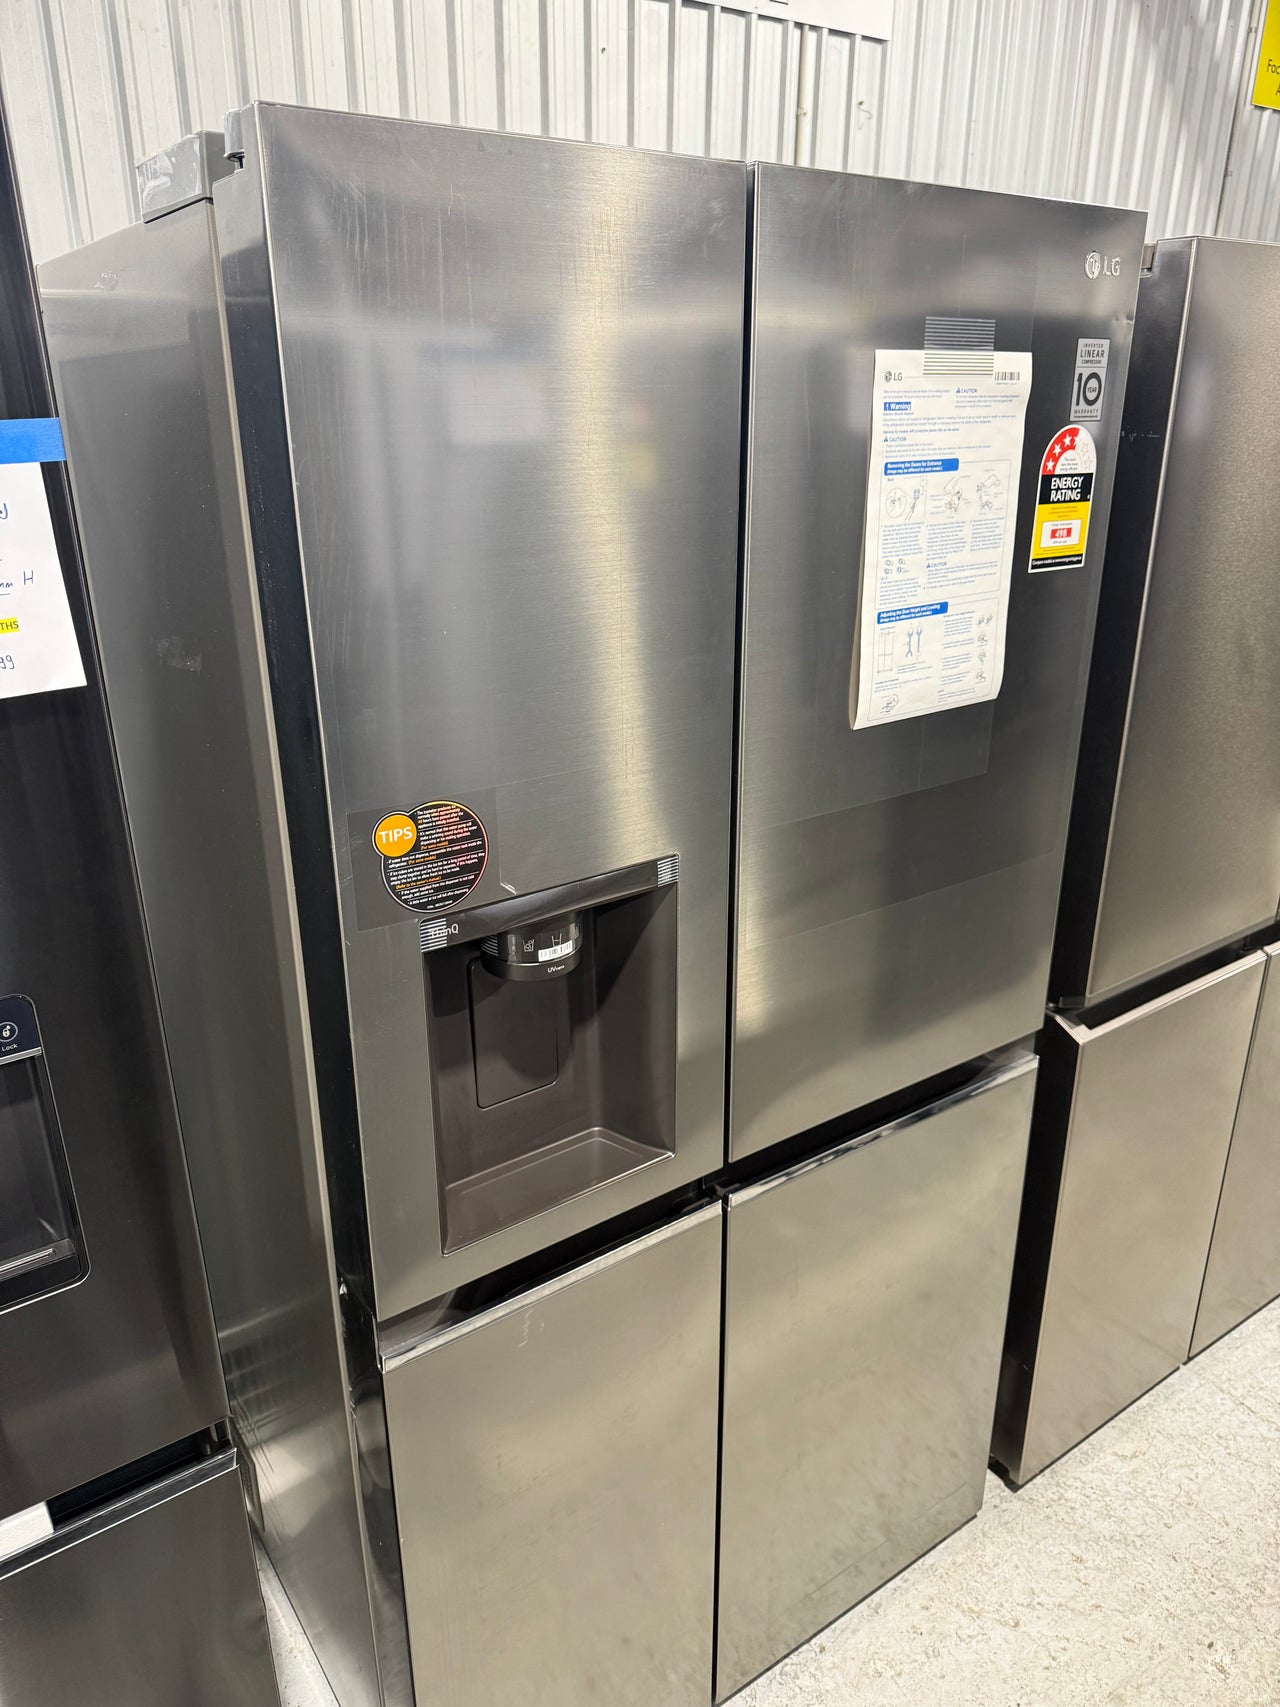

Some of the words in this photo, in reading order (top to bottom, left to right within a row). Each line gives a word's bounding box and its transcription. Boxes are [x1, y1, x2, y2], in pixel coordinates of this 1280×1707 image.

[1103, 256, 1120, 276] LG
[1080, 349, 1104, 358] LINEAR
[893, 372, 903, 381] LG
[1076, 372, 1102, 406] 10
[890, 402, 911, 411] Warning
[1050, 477, 1084, 489] ENERGY
[1050, 489, 1081, 502] RATING
[24, 570, 33, 585] H
[379, 826, 412, 844] TIPS
